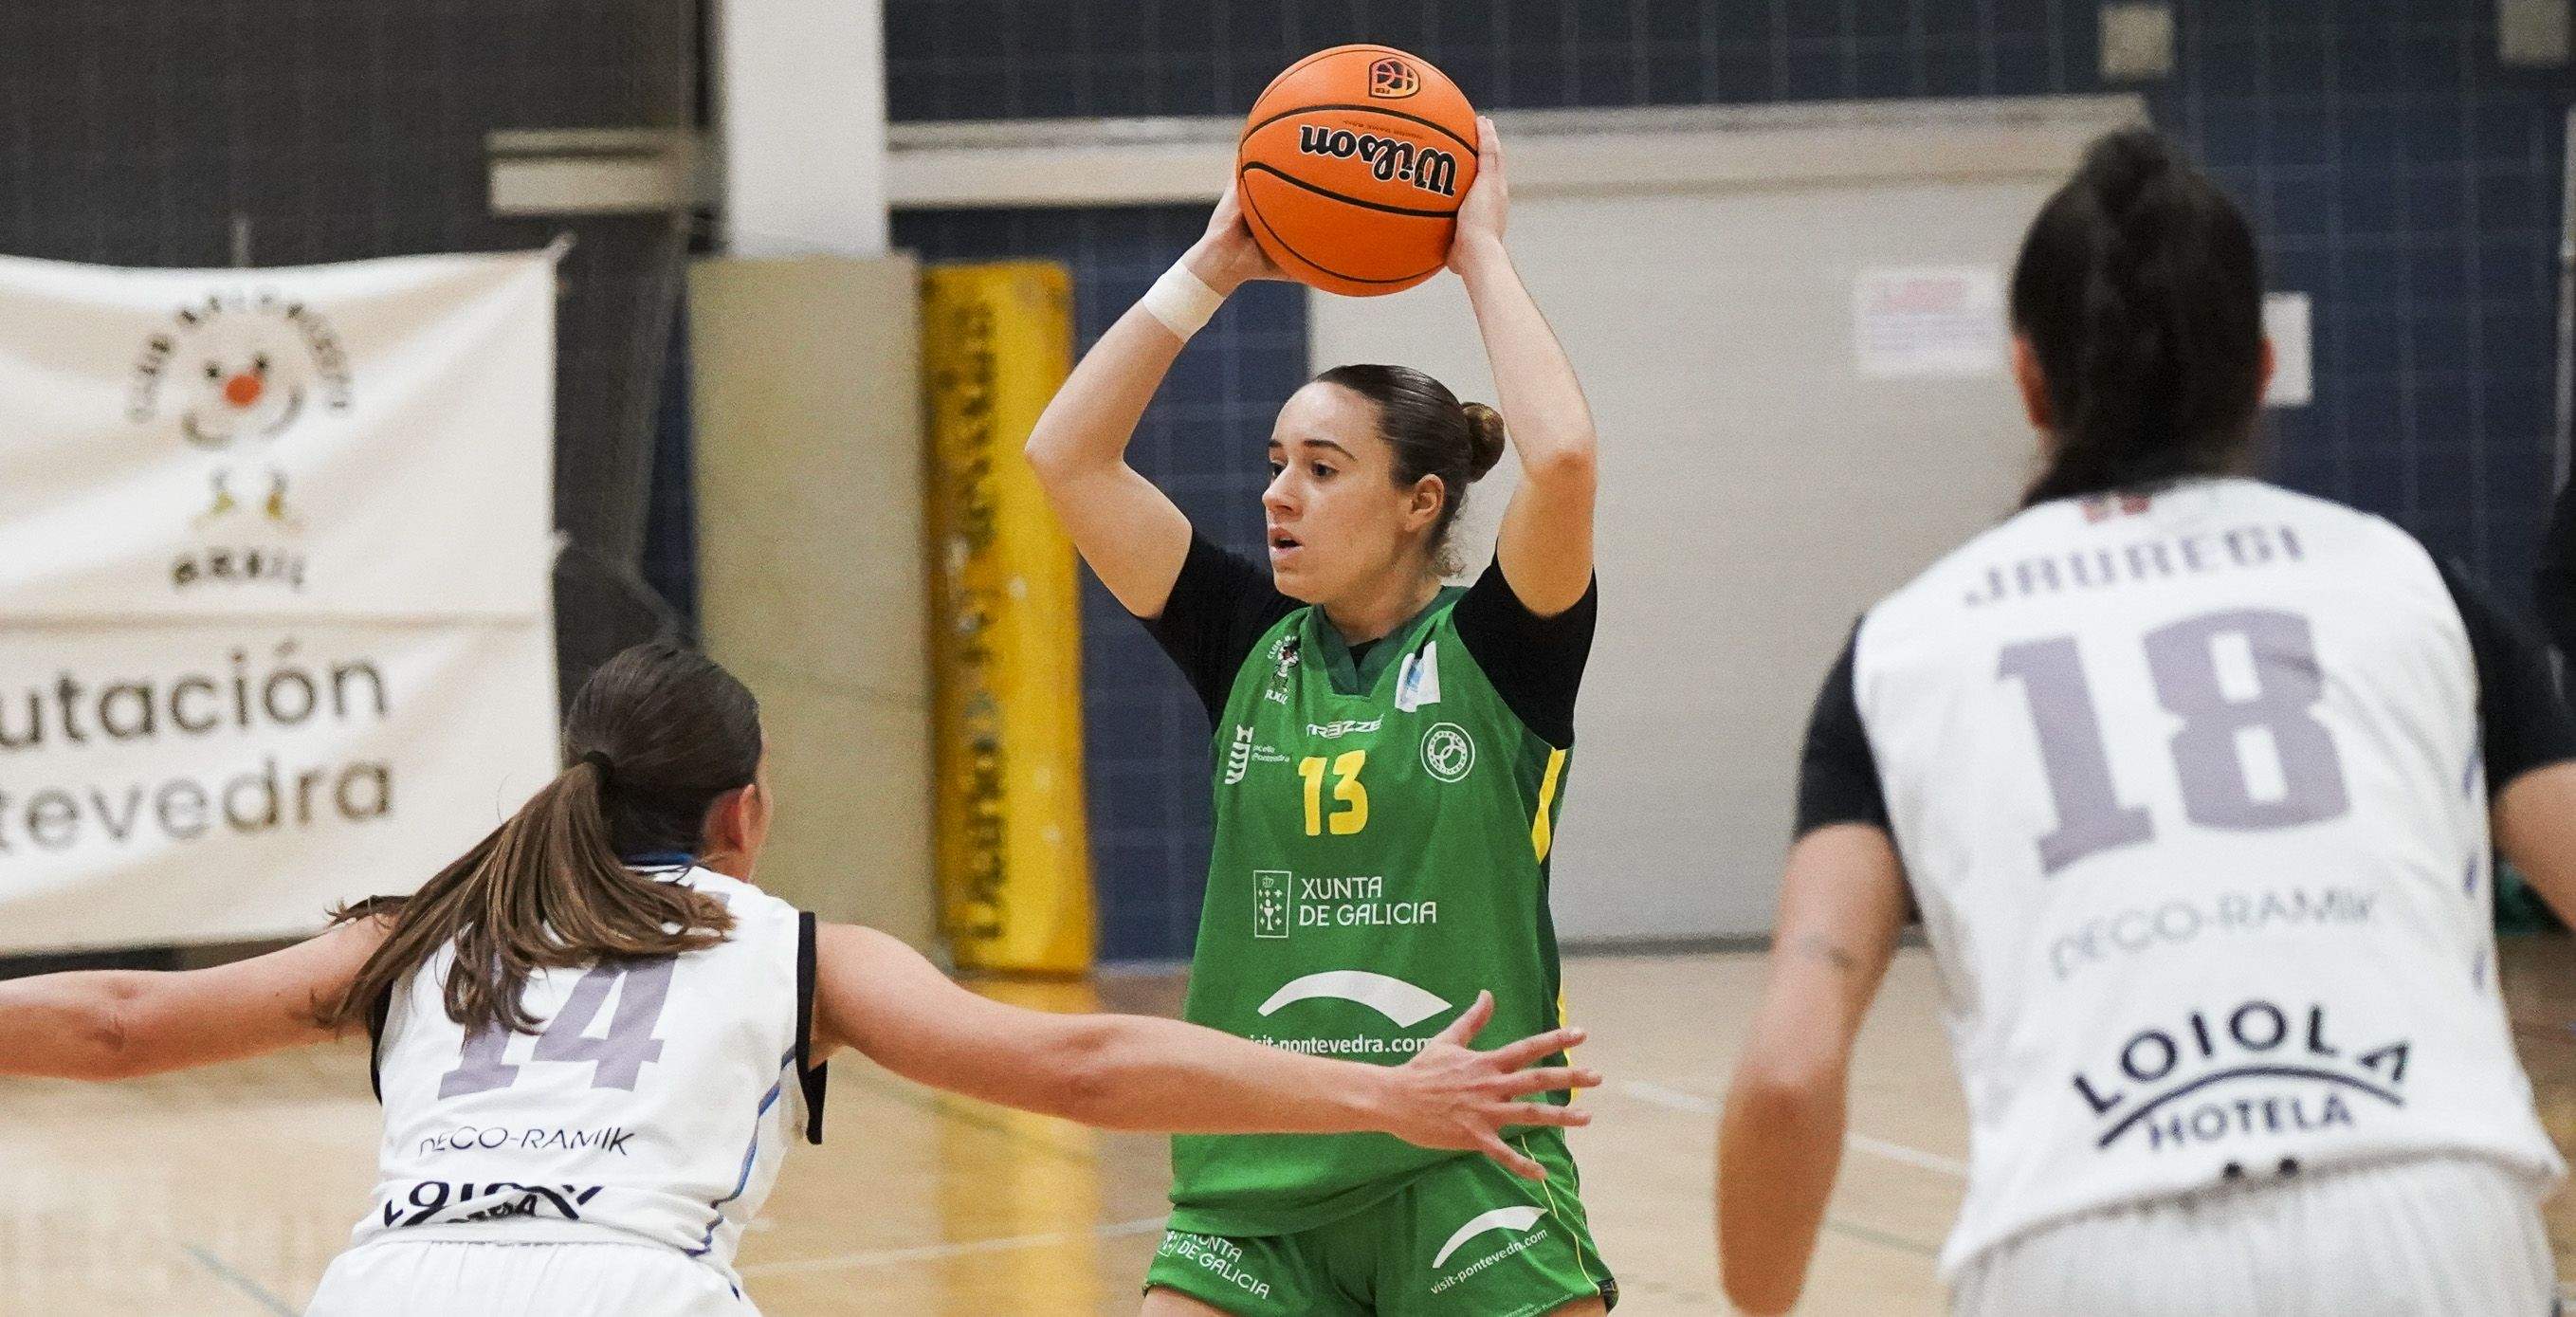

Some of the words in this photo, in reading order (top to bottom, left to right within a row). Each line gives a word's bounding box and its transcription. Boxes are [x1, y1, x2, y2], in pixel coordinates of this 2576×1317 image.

[1299, 124, 1457, 196] Wilson
[1964, 524, 2305, 607] JAUREGI
[1995, 607, 2353, 876] 18
[1298, 749, 1368, 836] 13
[1299, 905, 1330, 926] DE
[1337, 901, 1437, 926] GALICIA
[1301, 876, 1382, 900] XUNTA
[437, 954, 676, 1101] 14
[2072, 1000, 2410, 1118] LOIOLA
[2147, 1089, 2355, 1151] HOTELA
[1177, 1239, 1201, 1260] DE
[1198, 1253, 1270, 1300] GALICIA
